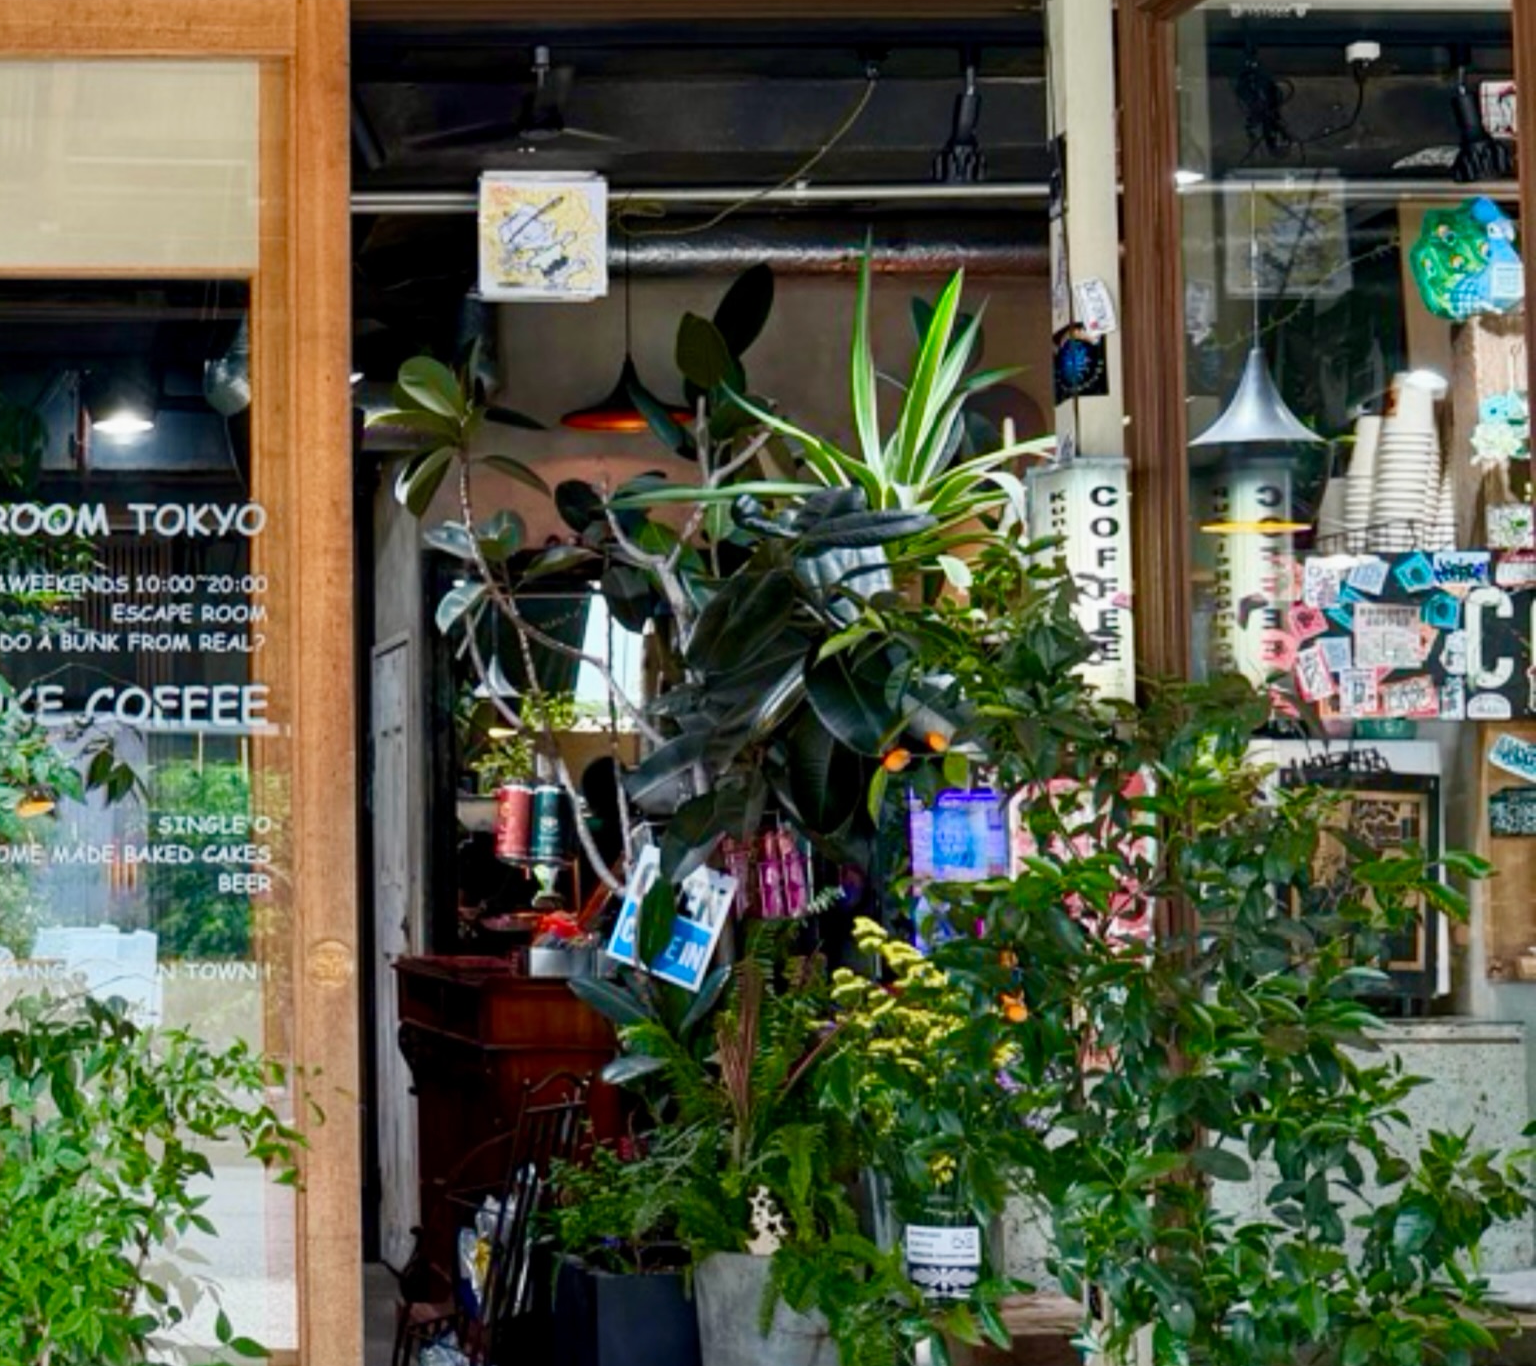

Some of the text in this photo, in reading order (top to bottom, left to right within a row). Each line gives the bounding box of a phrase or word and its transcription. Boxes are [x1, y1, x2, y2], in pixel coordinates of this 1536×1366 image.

[127, 501, 268, 538] TOKYO
[111, 603, 270, 623] ESCAPE ROOM
[0, 632, 35, 653] DO
[36, 632, 54, 653] A
[59, 632, 121, 653] BUNK
[127, 632, 190, 653] FROM
[198, 632, 267, 653] REAL?
[83, 684, 271, 728] COFFEE
[157, 814, 247, 836] SINGLE
[51, 844, 116, 866] MADE
[124, 844, 194, 866] BAKED
[200, 844, 273, 866] CAKES
[218, 873, 272, 895] BEER
[187, 964, 258, 982] TOWN
